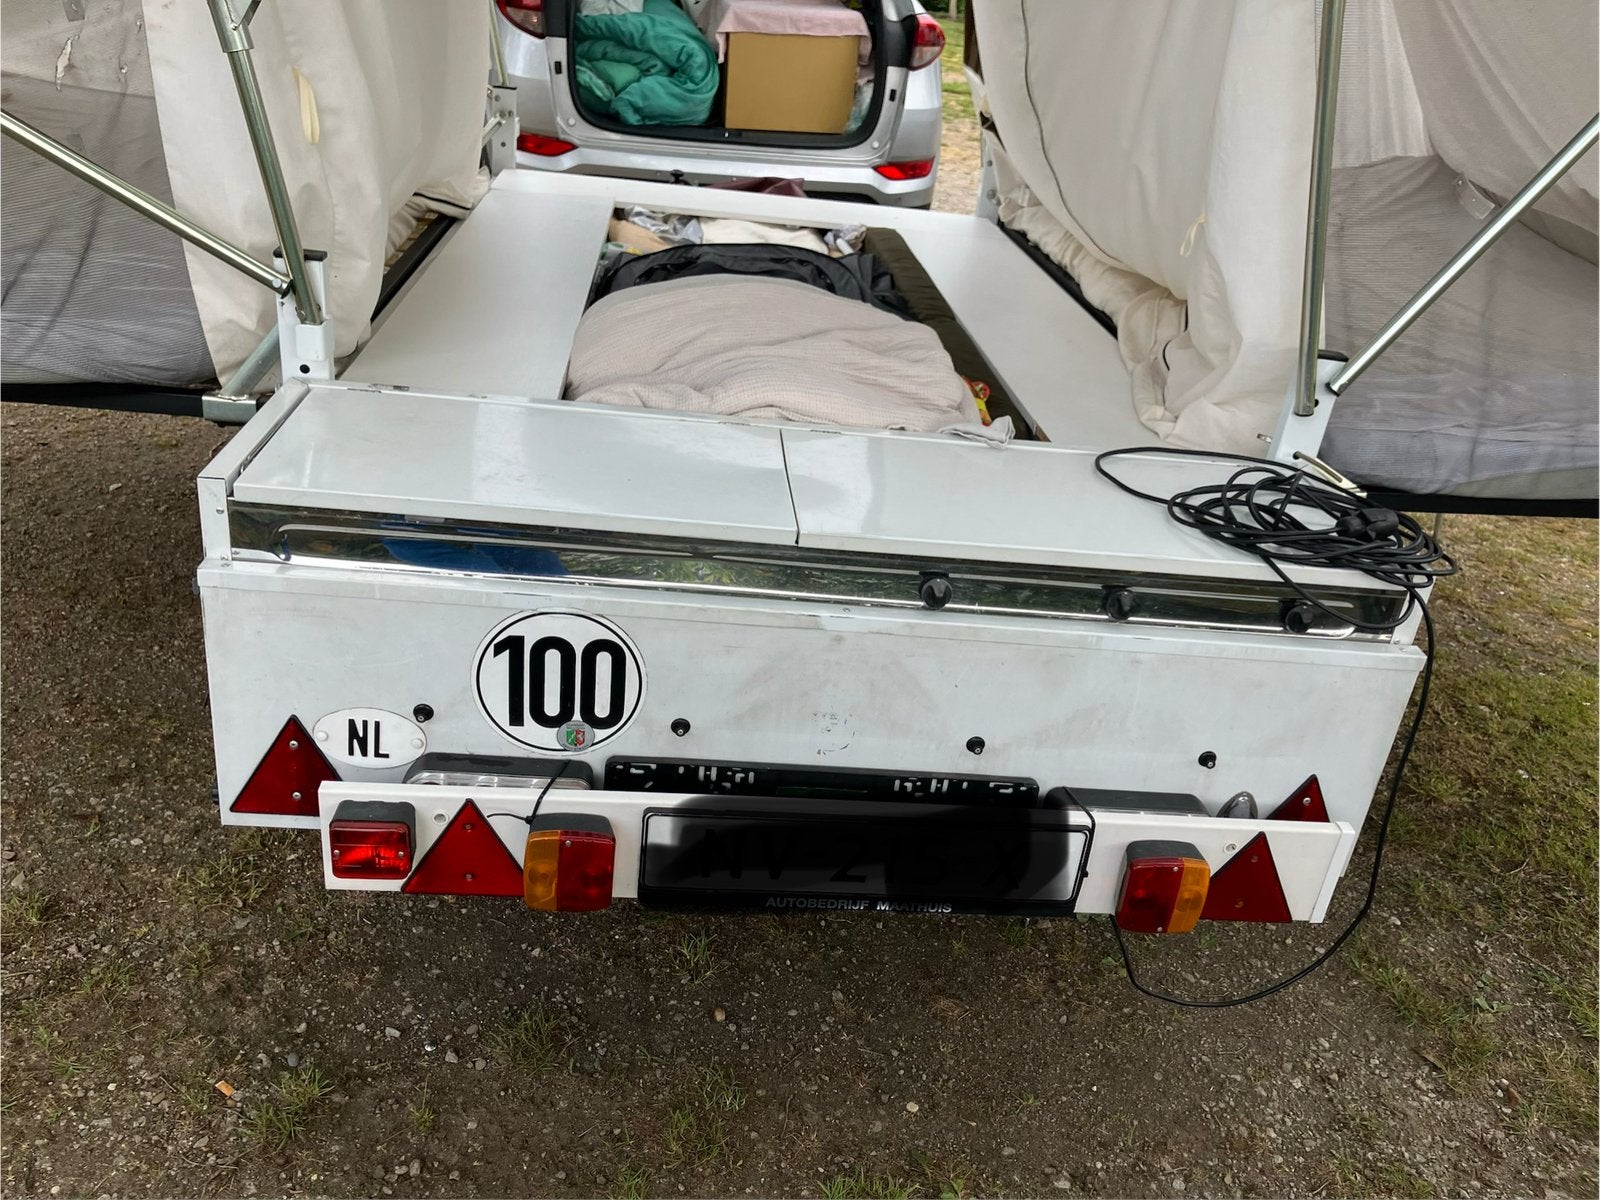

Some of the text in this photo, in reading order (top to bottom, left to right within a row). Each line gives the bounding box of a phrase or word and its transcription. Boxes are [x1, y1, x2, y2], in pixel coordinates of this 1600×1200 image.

[493, 635, 627, 730] 100
[347, 719, 390, 759] NL
[765, 897, 953, 913] AUTOBEDRIJF MAATHUIS
